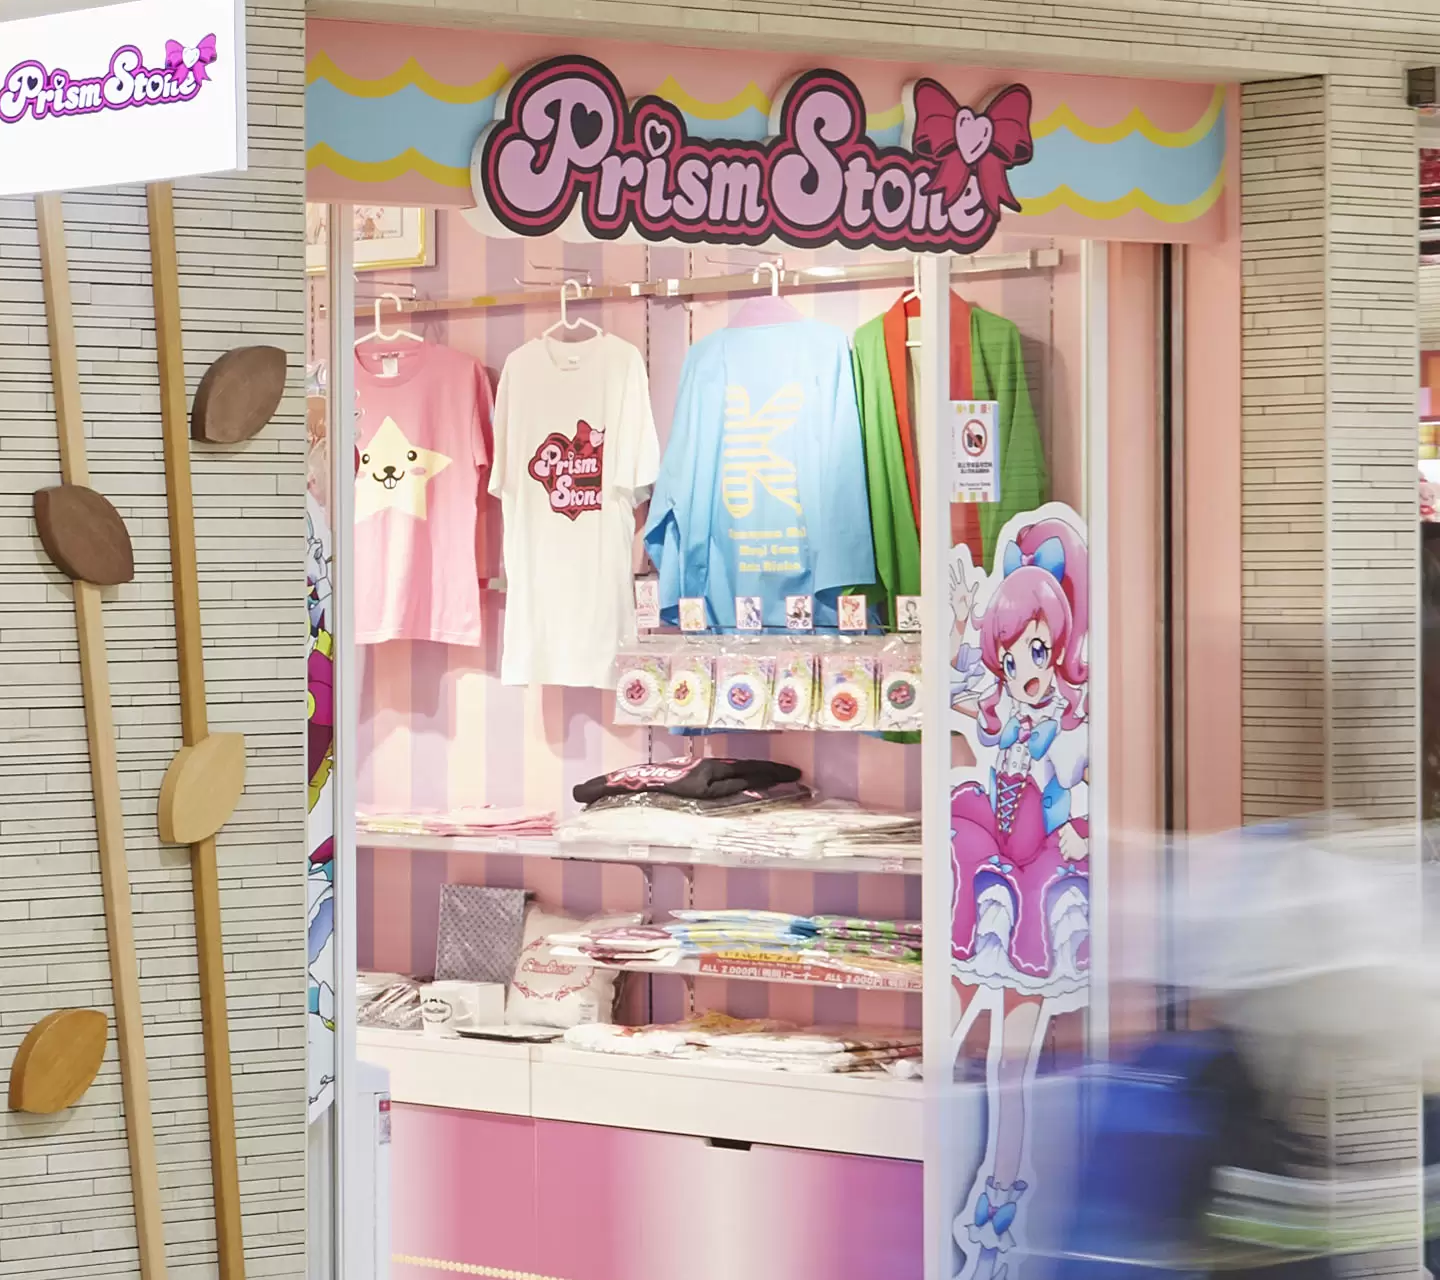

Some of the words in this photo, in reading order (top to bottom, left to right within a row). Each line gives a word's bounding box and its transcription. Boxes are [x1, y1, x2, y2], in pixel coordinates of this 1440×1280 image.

[102, 47, 200, 109] Stone
[494, 72, 767, 223] Prism
[769, 86, 987, 235] Stone
[533, 443, 599, 478] Prism
